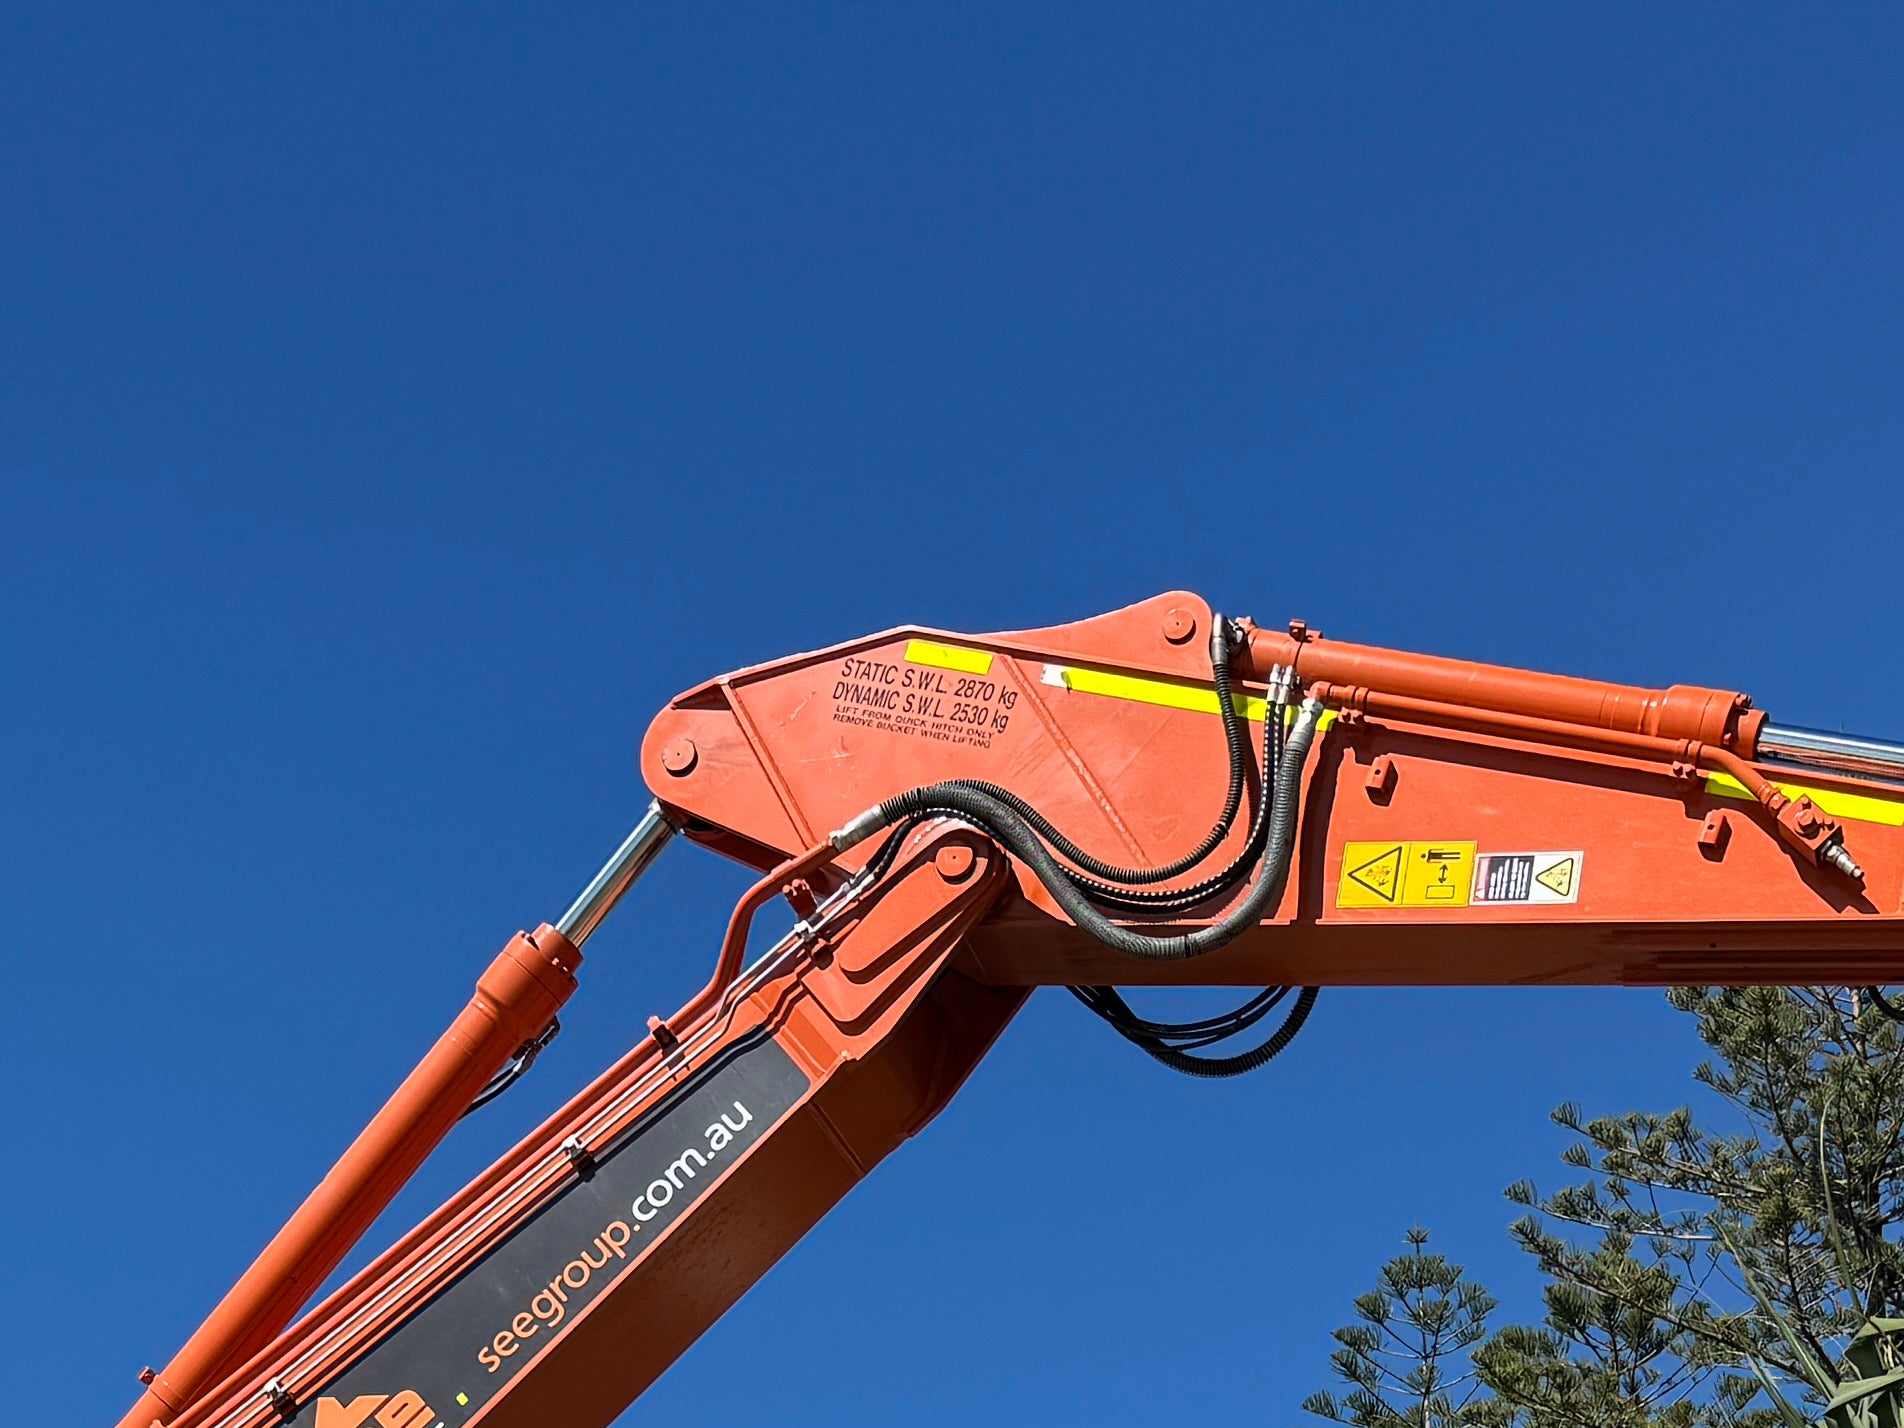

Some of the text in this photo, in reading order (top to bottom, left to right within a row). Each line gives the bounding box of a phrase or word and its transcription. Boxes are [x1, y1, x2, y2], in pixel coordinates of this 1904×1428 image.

[832, 681, 901, 711] DYNAMIC
[949, 702, 989, 726] 2530
[990, 709, 1009, 734] kg
[841, 657, 898, 685] STATIC
[954, 678, 996, 702] 2870
[997, 685, 1019, 710] kg
[832, 713, 991, 749] REMOVE BUCKET WHEN LIFTING
[836, 704, 995, 741] LIFT FROM QUICK HITCH ONLY
[477, 1100, 753, 1373] seegroup.com.au
